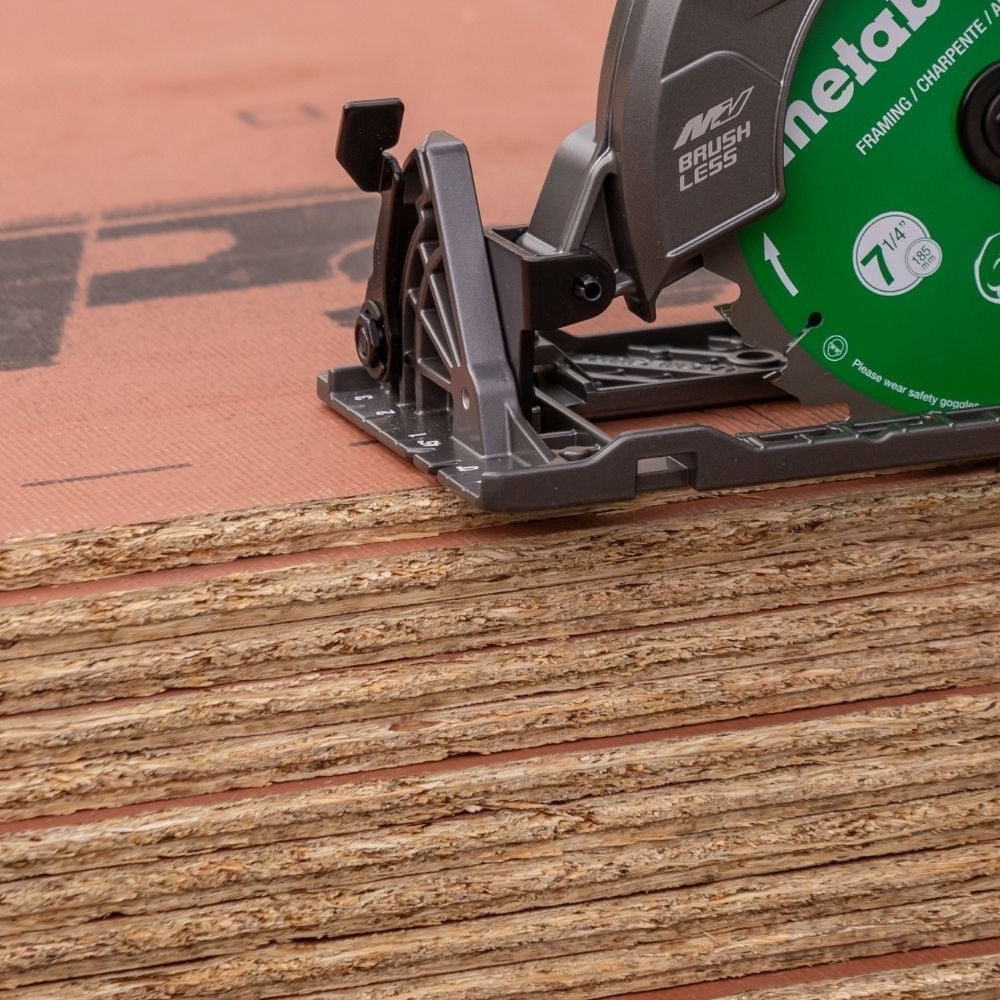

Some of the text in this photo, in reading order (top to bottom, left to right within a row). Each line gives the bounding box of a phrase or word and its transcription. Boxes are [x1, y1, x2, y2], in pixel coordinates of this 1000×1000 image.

[855, 96, 912, 156] FRAMING
[916, 18, 987, 94] CHARPENTE
[678, 120, 750, 173] BRUSH
[679, 147, 737, 192] LESS
[860, 243, 896, 287] 7
[911, 244, 932, 266] 185
[921, 254, 936, 271] mm
[852, 358, 883, 383] Please
[883, 378, 908, 394] wear
[908, 388, 938, 406] safety
